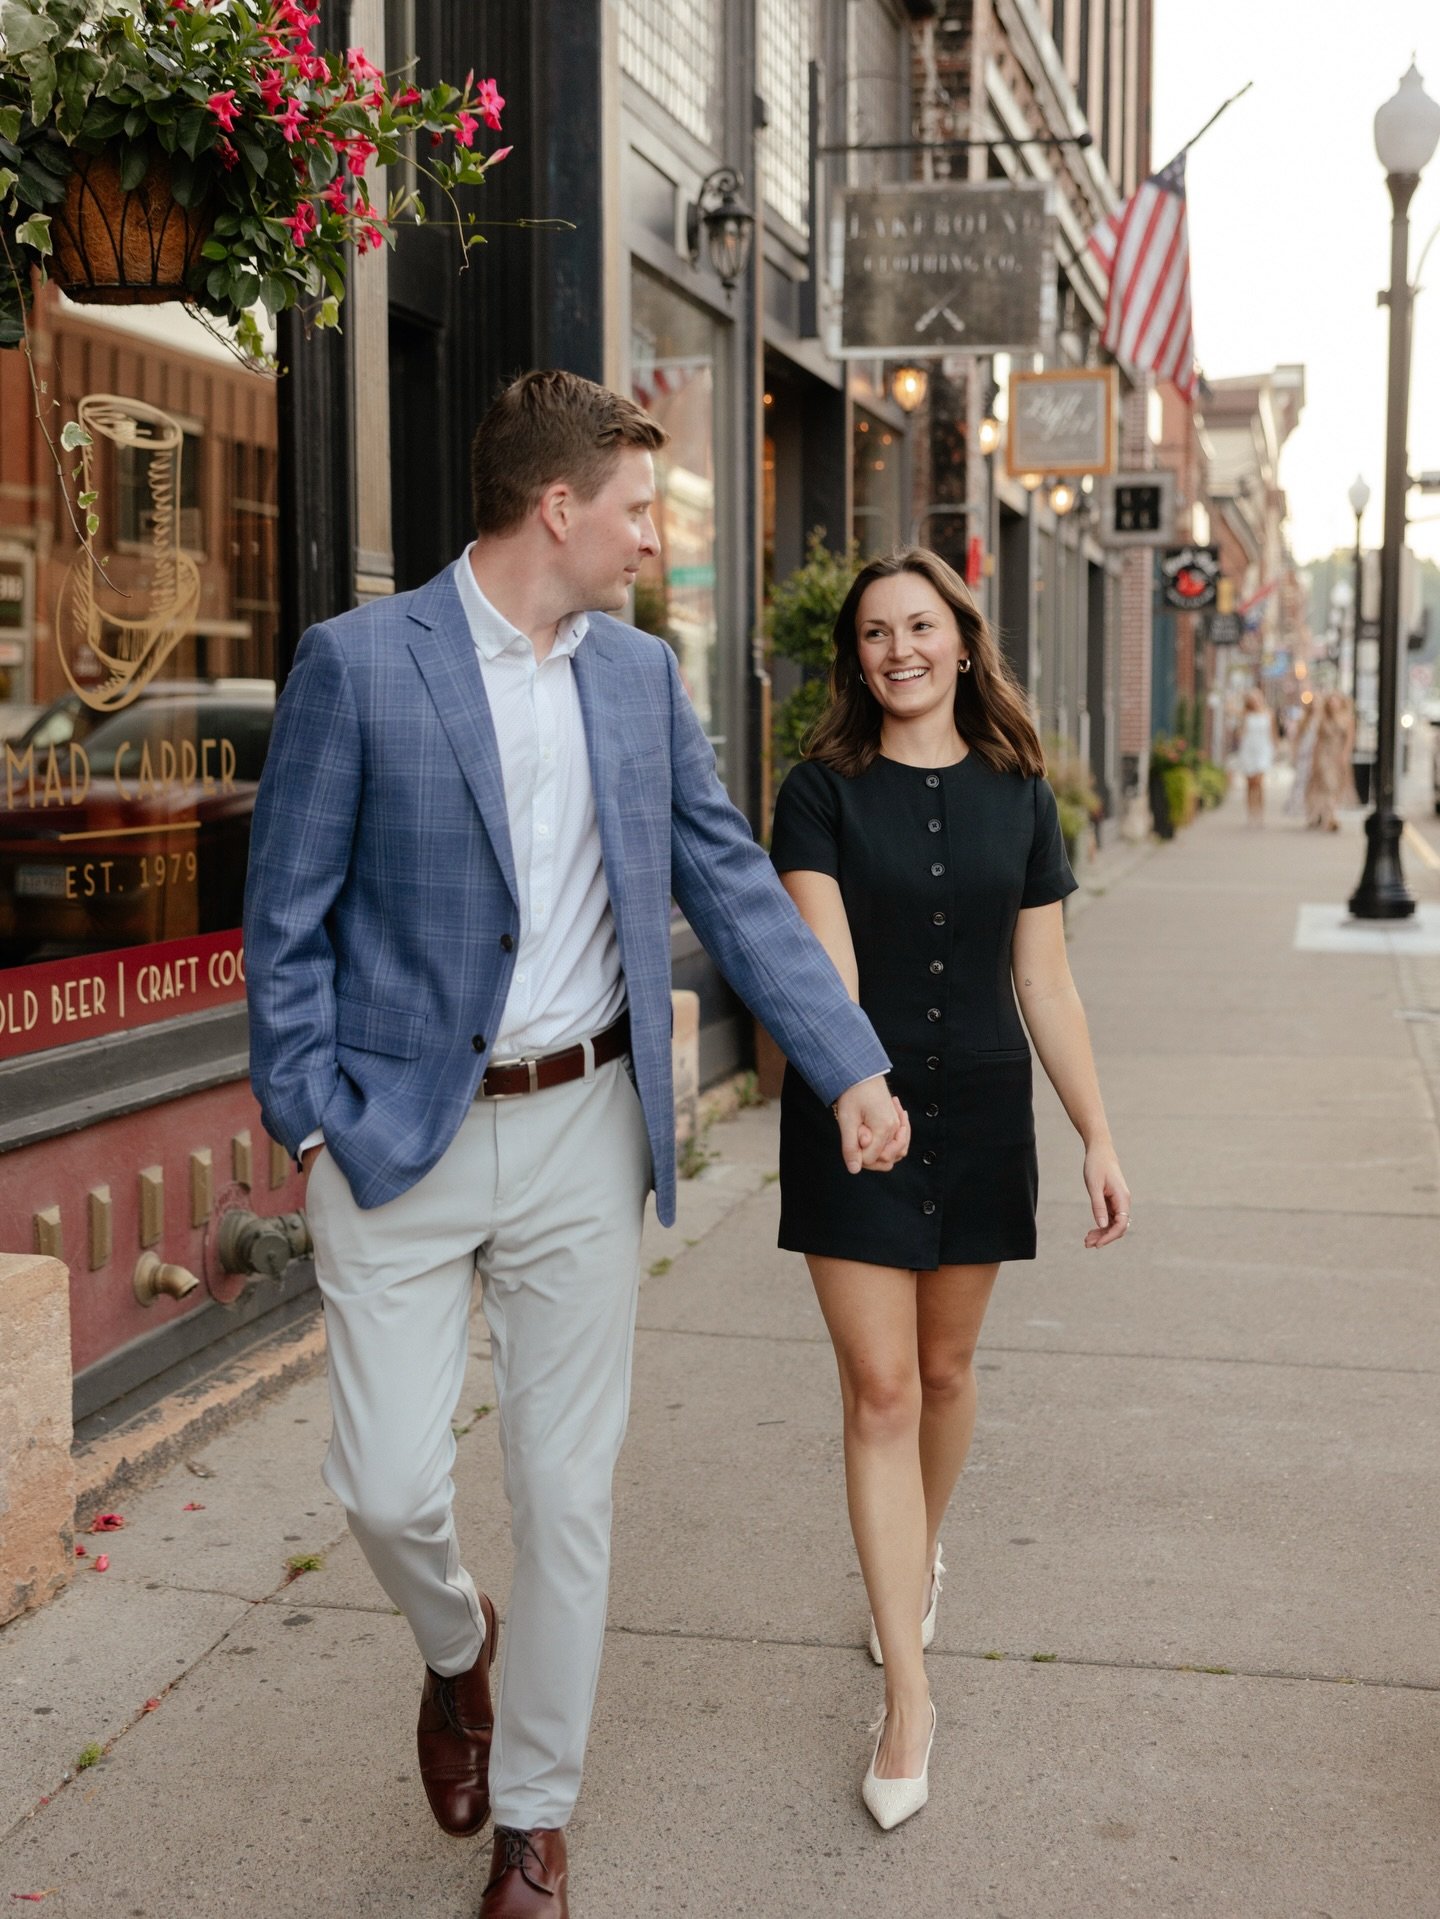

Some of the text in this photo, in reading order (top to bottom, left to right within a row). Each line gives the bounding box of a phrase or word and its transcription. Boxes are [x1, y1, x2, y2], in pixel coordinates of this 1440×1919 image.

[5, 738, 237, 810] MAD CAPPER
[65, 861, 124, 899] EST.
[139, 851, 197, 888] 1979
[50, 976, 106, 1025] BEER
[136, 956, 199, 1004] CRAFT
